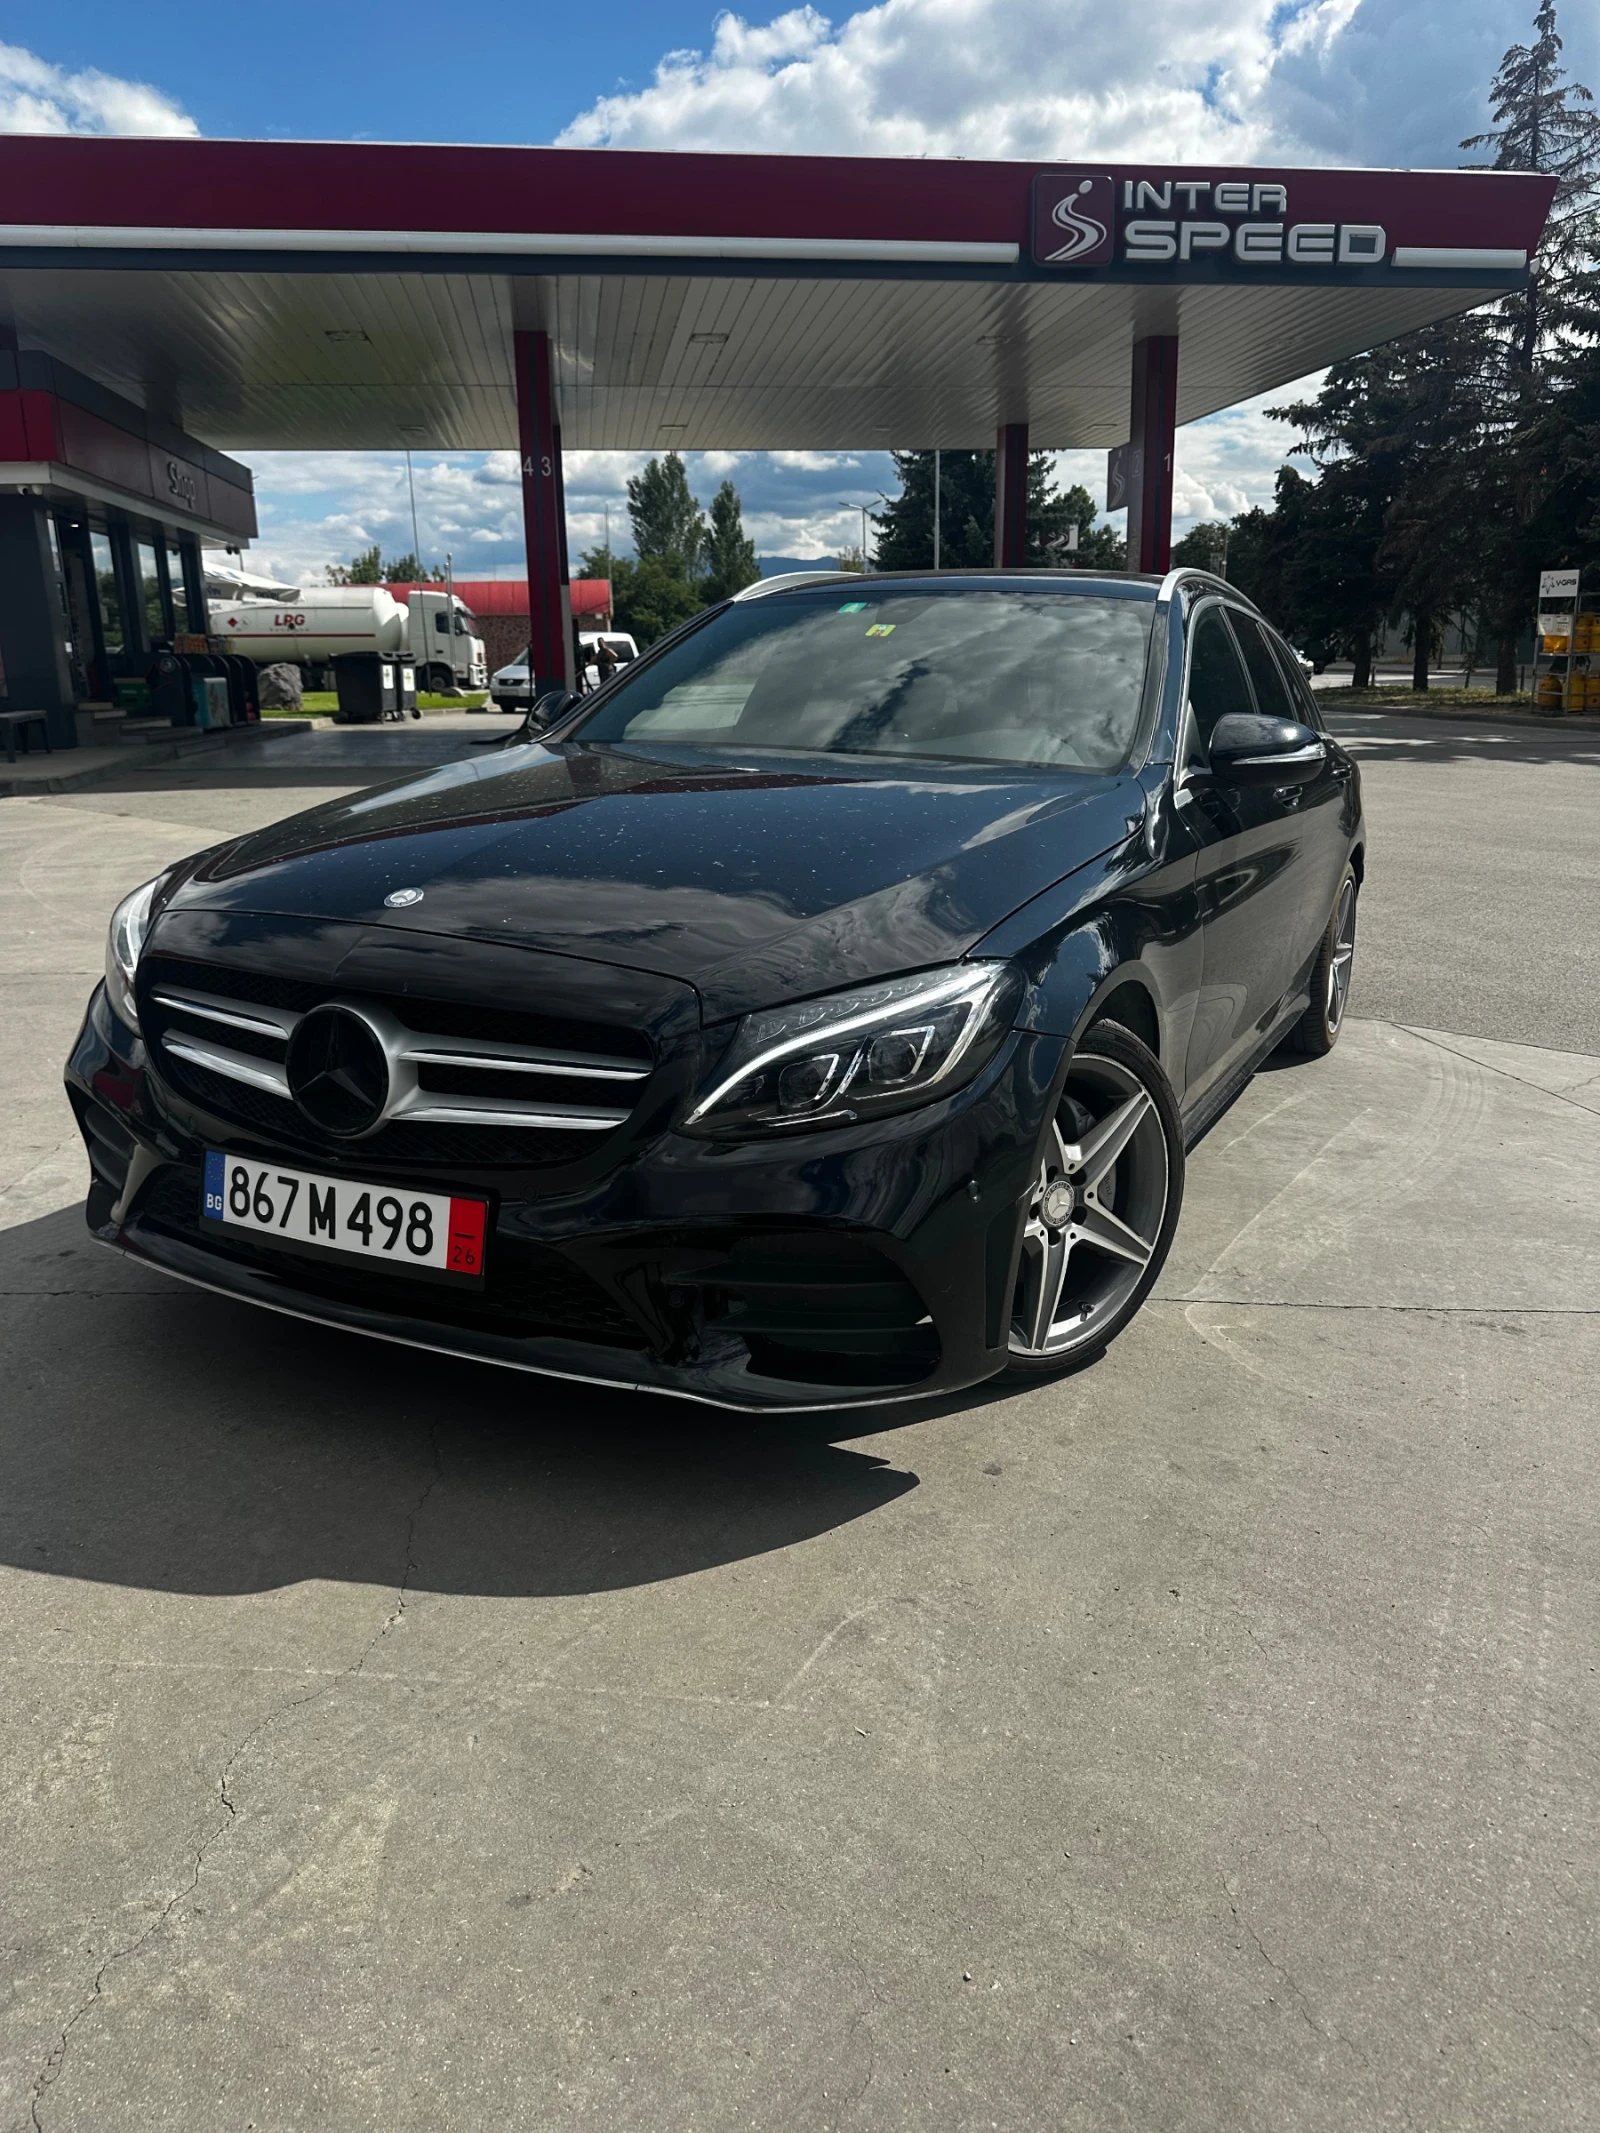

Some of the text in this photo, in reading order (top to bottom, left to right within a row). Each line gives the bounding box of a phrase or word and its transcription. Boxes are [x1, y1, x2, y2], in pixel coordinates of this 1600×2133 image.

[1123, 180, 1288, 214] INTER
[1125, 220, 1387, 264] SPEED
[522, 456, 552, 477] 4 3
[1164, 453, 1171, 472] 1
[167, 461, 197, 511] Shop
[206, 1193, 223, 1211] BG
[229, 1165, 434, 1257] 867 M 498
[452, 1245, 476, 1266] 26
